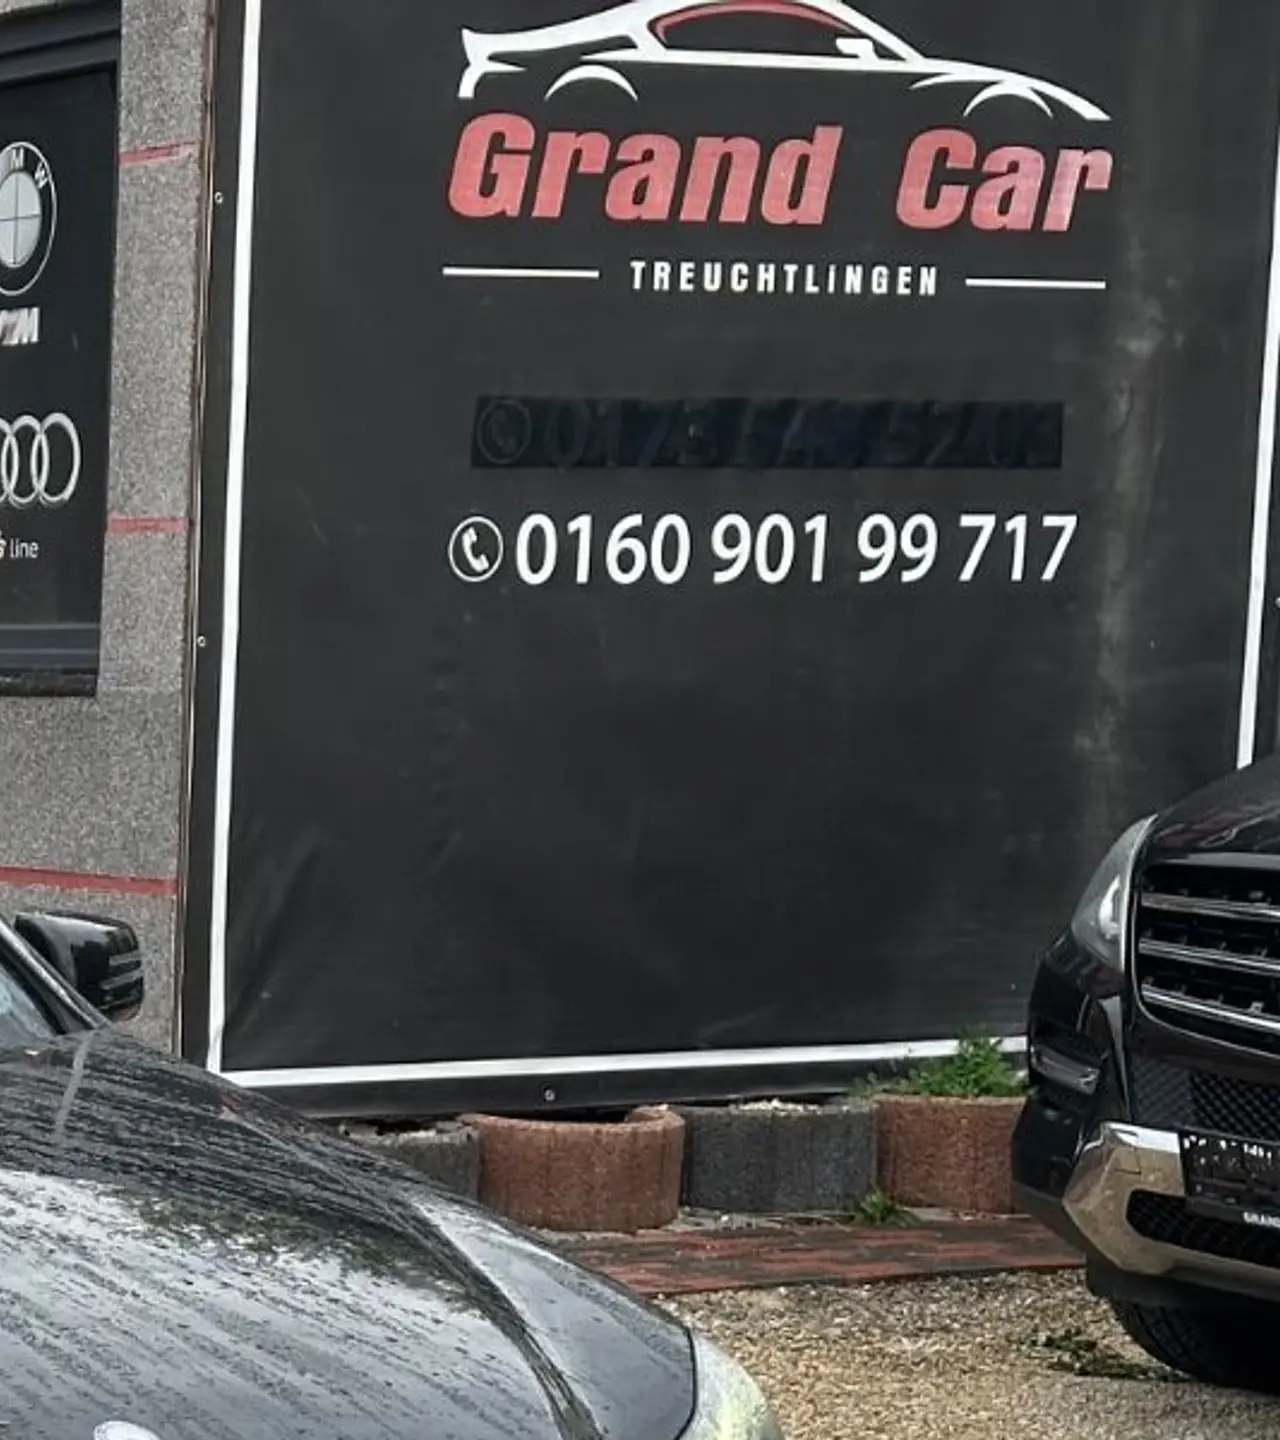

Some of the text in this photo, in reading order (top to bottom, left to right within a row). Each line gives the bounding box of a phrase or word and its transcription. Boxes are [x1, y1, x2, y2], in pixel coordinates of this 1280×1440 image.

[447, 112, 1113, 233] Grand Car
[629, 259, 939, 297] TREUCHTLINGEN
[9, 537, 40, 559] line
[515, 513, 1078, 586] 0160 901 99 717
